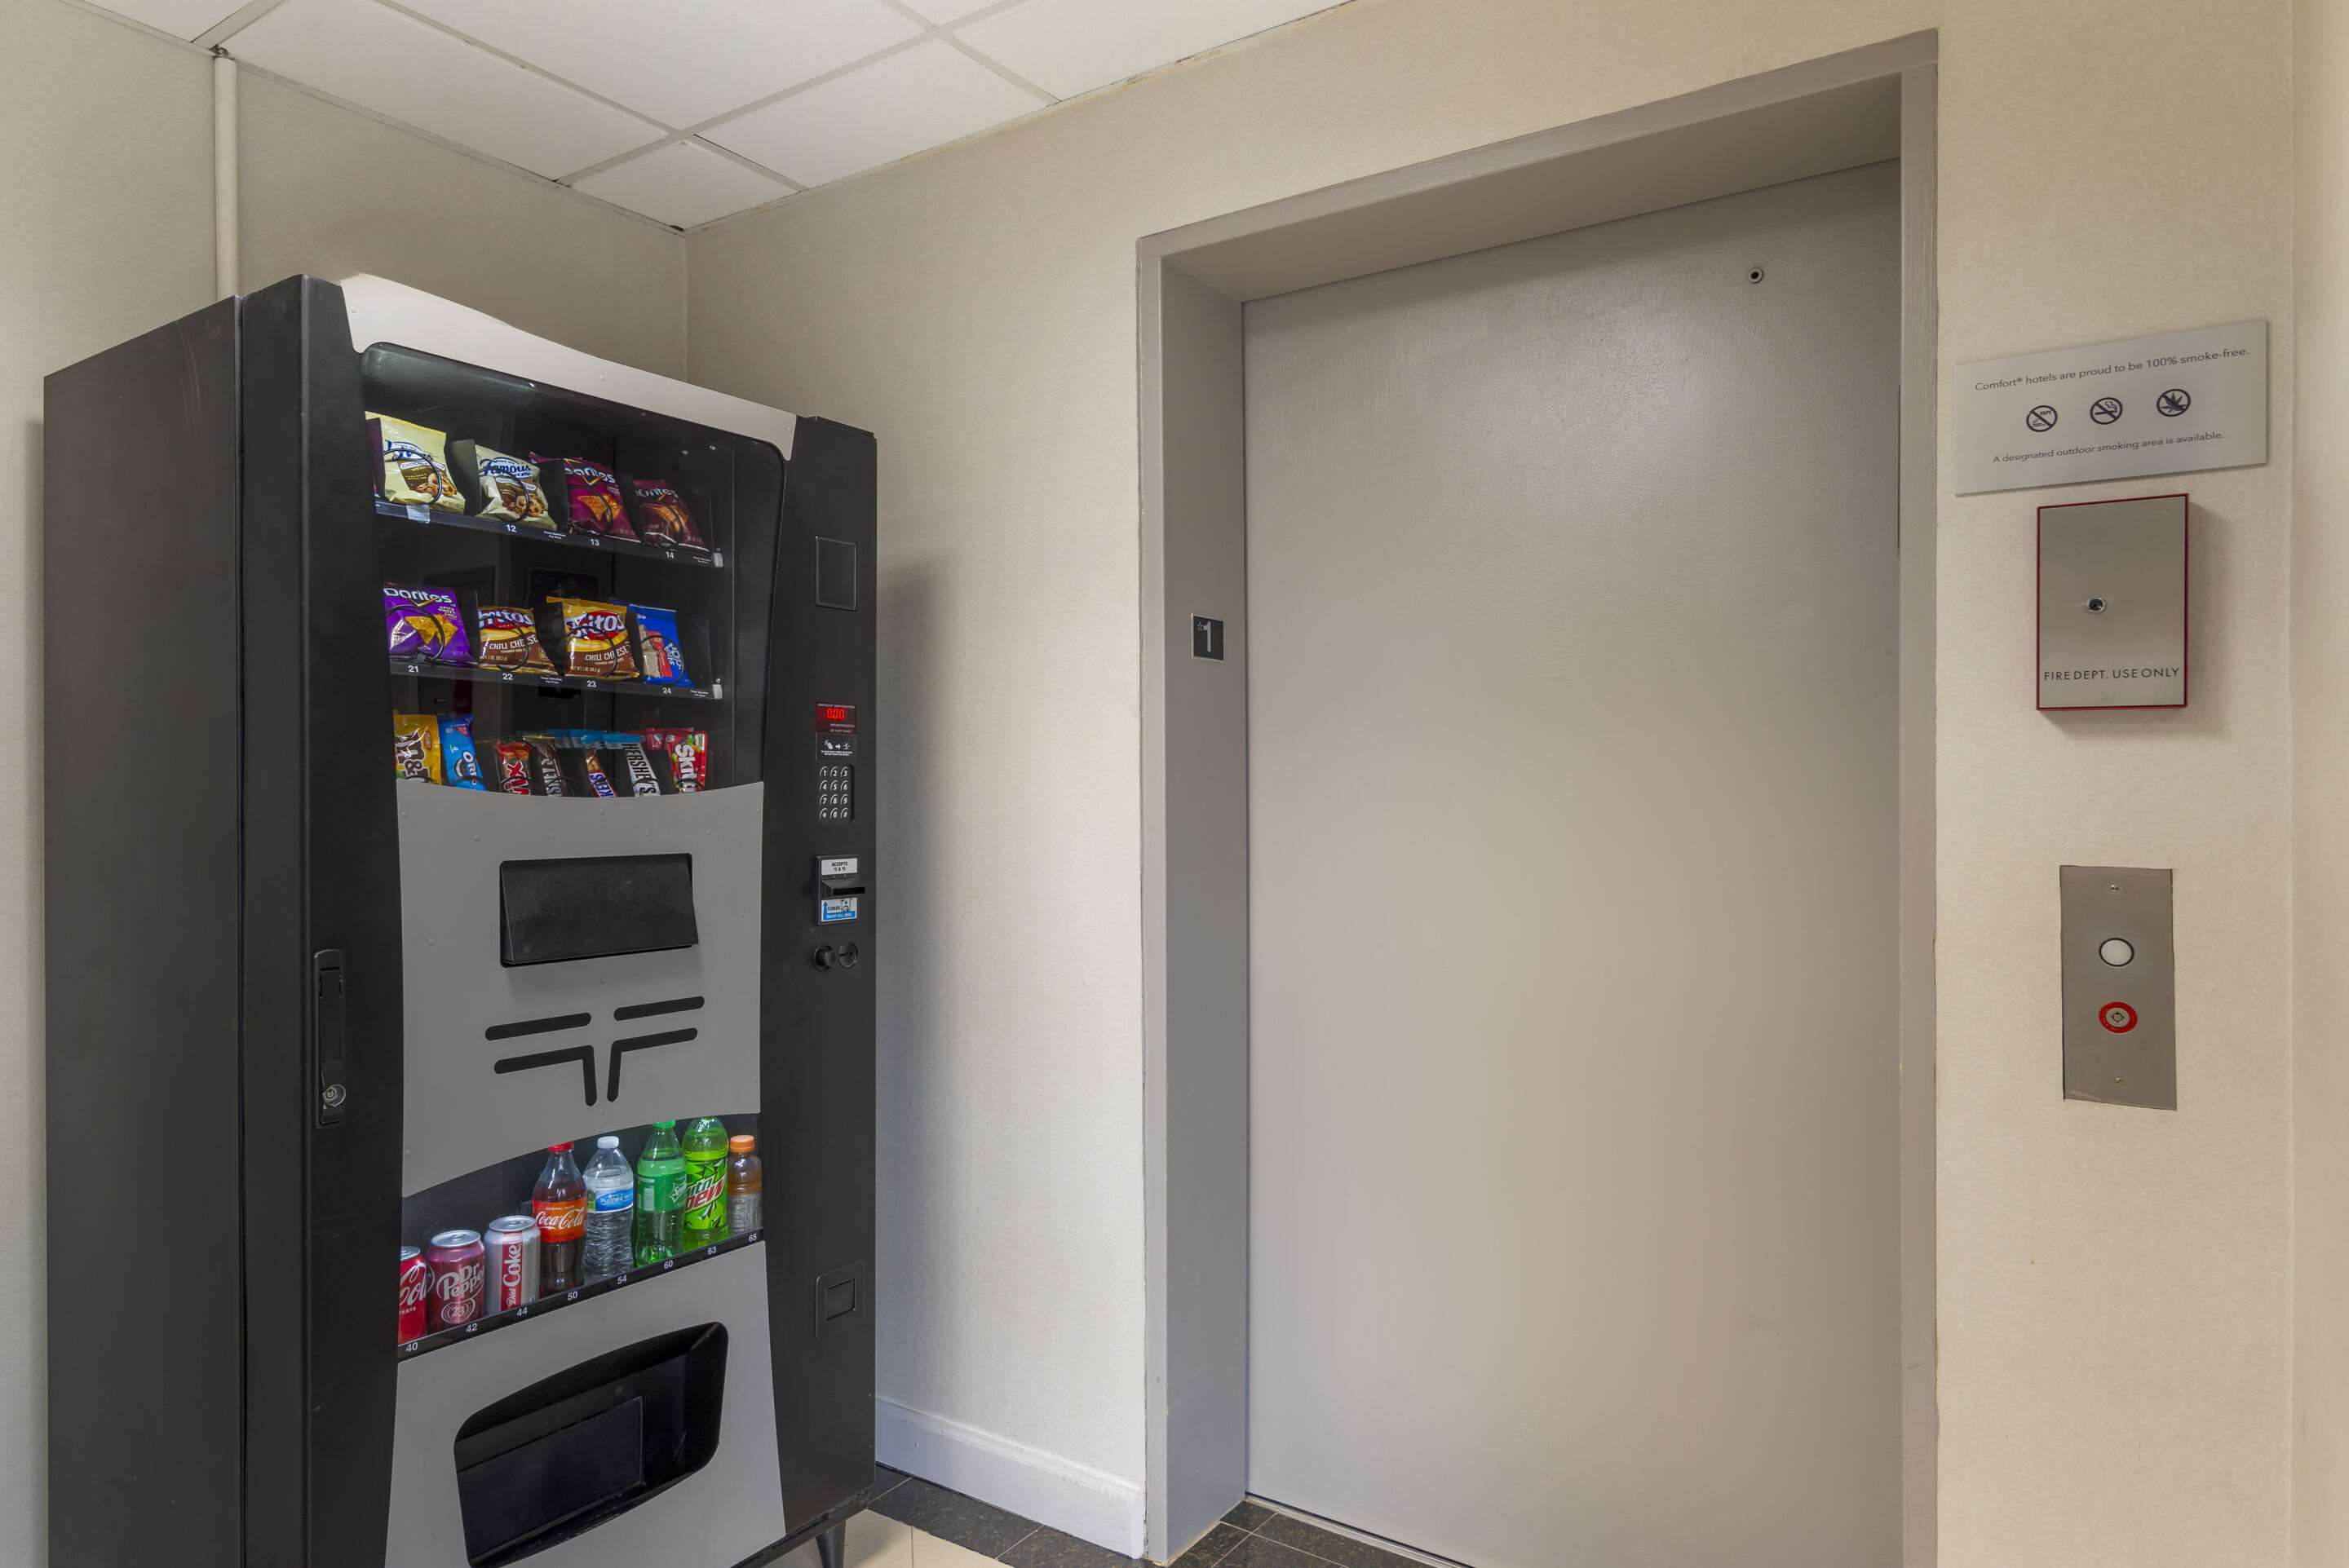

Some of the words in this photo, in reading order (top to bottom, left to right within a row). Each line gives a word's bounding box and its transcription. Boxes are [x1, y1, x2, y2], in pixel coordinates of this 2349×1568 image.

[2026, 373, 2057, 384] hotels
[2059, 372, 2077, 380] are
[2079, 365, 2111, 379] proud
[2114, 364, 2126, 373] to
[2129, 362, 2143, 371] be
[2147, 356, 2178, 368] 100%
[2180, 348, 2249, 364] smoke-free.
[1993, 455, 2000, 463] A
[2002, 448, 2055, 462] designated
[2056, 447, 2095, 457] outdoor
[2098, 441, 2139, 453] smoking
[2142, 439, 2163, 448] area
[2166, 436, 2174, 444] is
[2176, 431, 2224, 444] available.
[506, 524, 517, 532] 12
[590, 538, 600, 546] 13
[666, 551, 675, 559] 14
[383, 588, 453, 603] Doritos
[489, 641, 507, 650] CHILI
[510, 634, 538, 649] CHESE
[1203, 621, 1211, 652] 1
[585, 653, 602, 661] CHILI
[502, 673, 514, 681] 22
[2044, 671, 2071, 681] FIRE
[2074, 669, 2109, 680] DEPT.
[2112, 669, 2138, 678] USE
[2141, 667, 2179, 678] ONLY
[536, 1207, 586, 1230] Coca-Cola
[749, 1233, 758, 1242] 65
[707, 1246, 717, 1255] 63
[502, 1242, 522, 1287] Coke
[664, 1259, 674, 1269] 60
[458, 1263, 480, 1283] Dr
[617, 1274, 627, 1284] 54
[436, 1270, 484, 1301] Peppe
[568, 1291, 578, 1301] 50
[516, 1306, 529, 1317] 44
[466, 1323, 478, 1333] 42
[406, 1341, 418, 1352] 40
